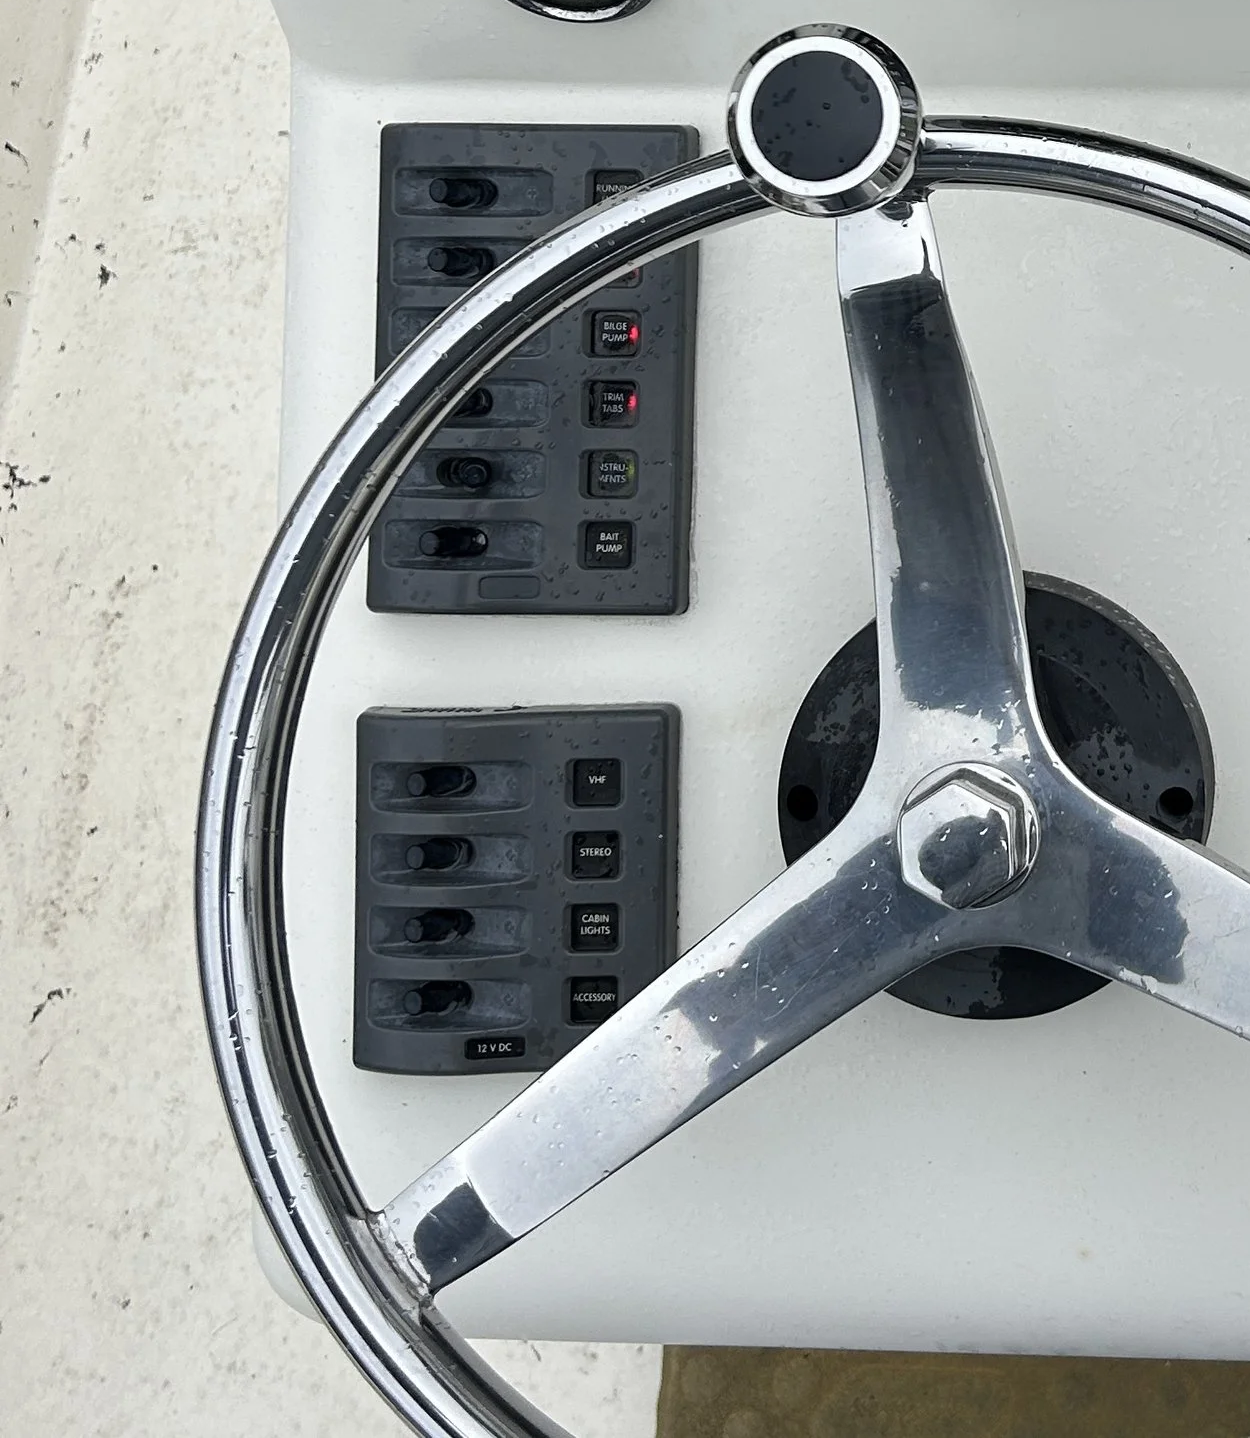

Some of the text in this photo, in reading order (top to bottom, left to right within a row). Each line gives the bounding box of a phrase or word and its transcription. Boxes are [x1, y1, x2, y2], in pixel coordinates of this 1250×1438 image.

[603, 321, 628, 331] BILGE
[602, 333, 629, 342] PUMP
[603, 392, 625, 402] TRIM
[602, 404, 624, 413] TABS
[600, 532, 619, 541] BAIT
[595, 544, 623, 553] PUMP
[588, 775, 607, 784] VHF
[579, 847, 613, 857] STEREO
[581, 914, 610, 923] CABIN
[580, 926, 611, 935] LIGHTS
[573, 992, 616, 1002] ACCESSORY
[477, 1042, 512, 1053] 12 V DC
